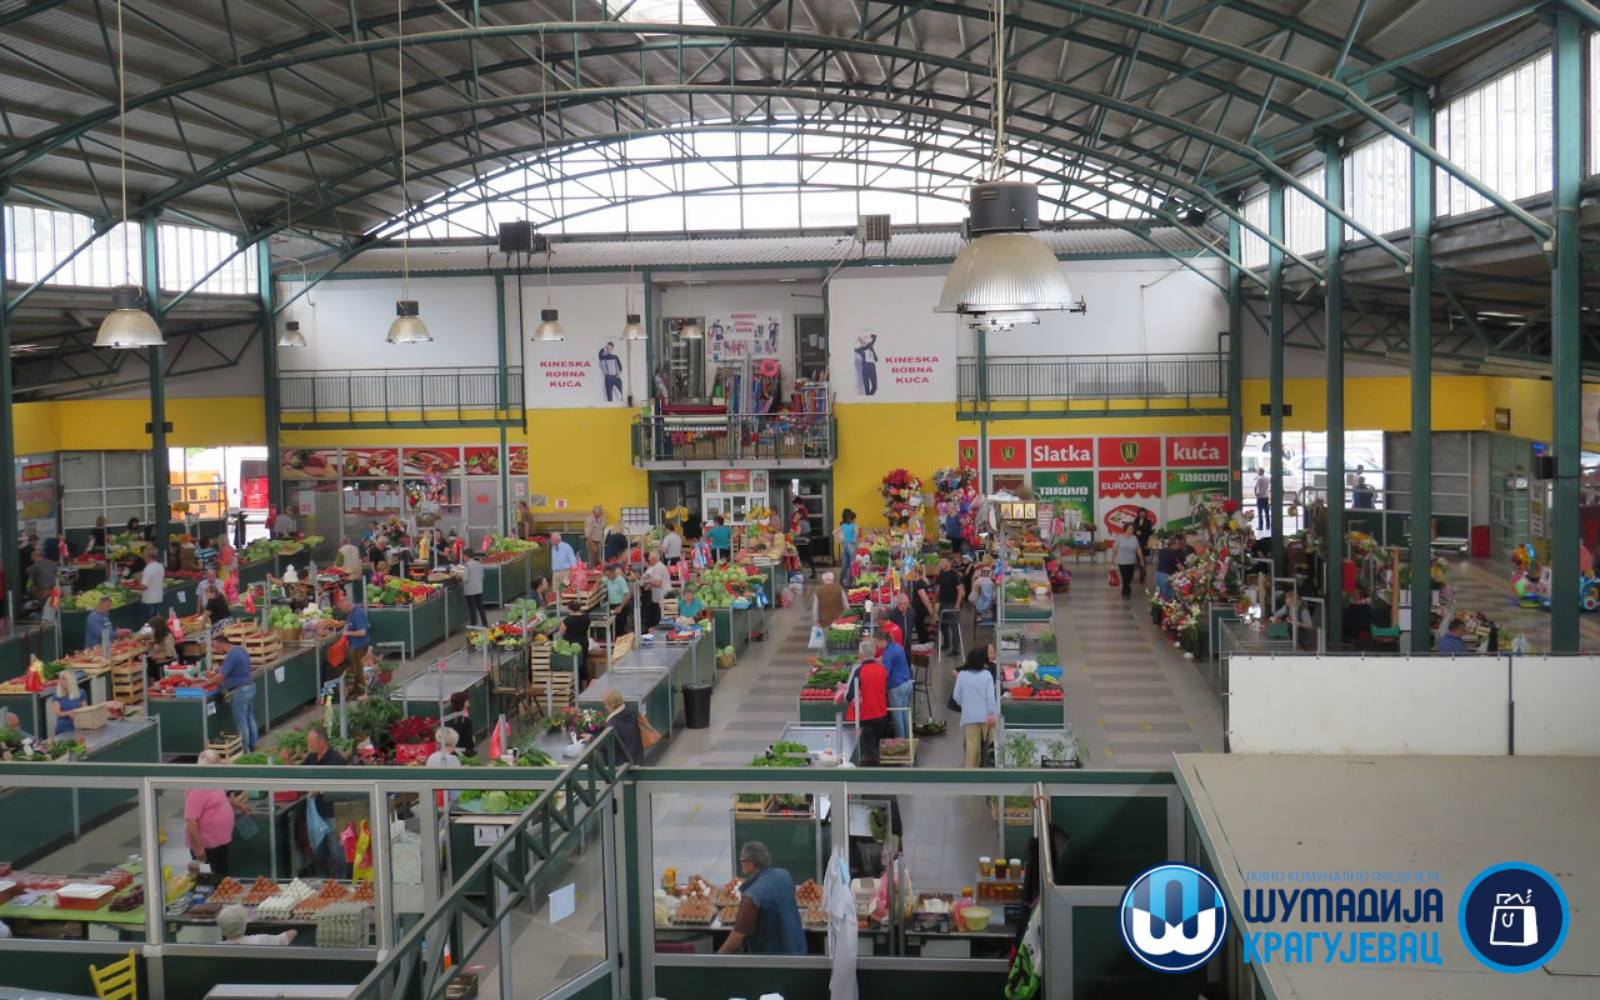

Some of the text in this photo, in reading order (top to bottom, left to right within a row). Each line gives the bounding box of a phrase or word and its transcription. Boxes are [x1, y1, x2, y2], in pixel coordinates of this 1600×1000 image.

[540, 360, 592, 368] KINESKA
[885, 356, 940, 364] KINESKA
[890, 366, 934, 374] ROBNA
[1033, 444, 1091, 462] Slatka
[1173, 441, 1220, 460] kuća
[1118, 472, 1132, 481] JA
[1101, 482, 1158, 490] EUROCREM
